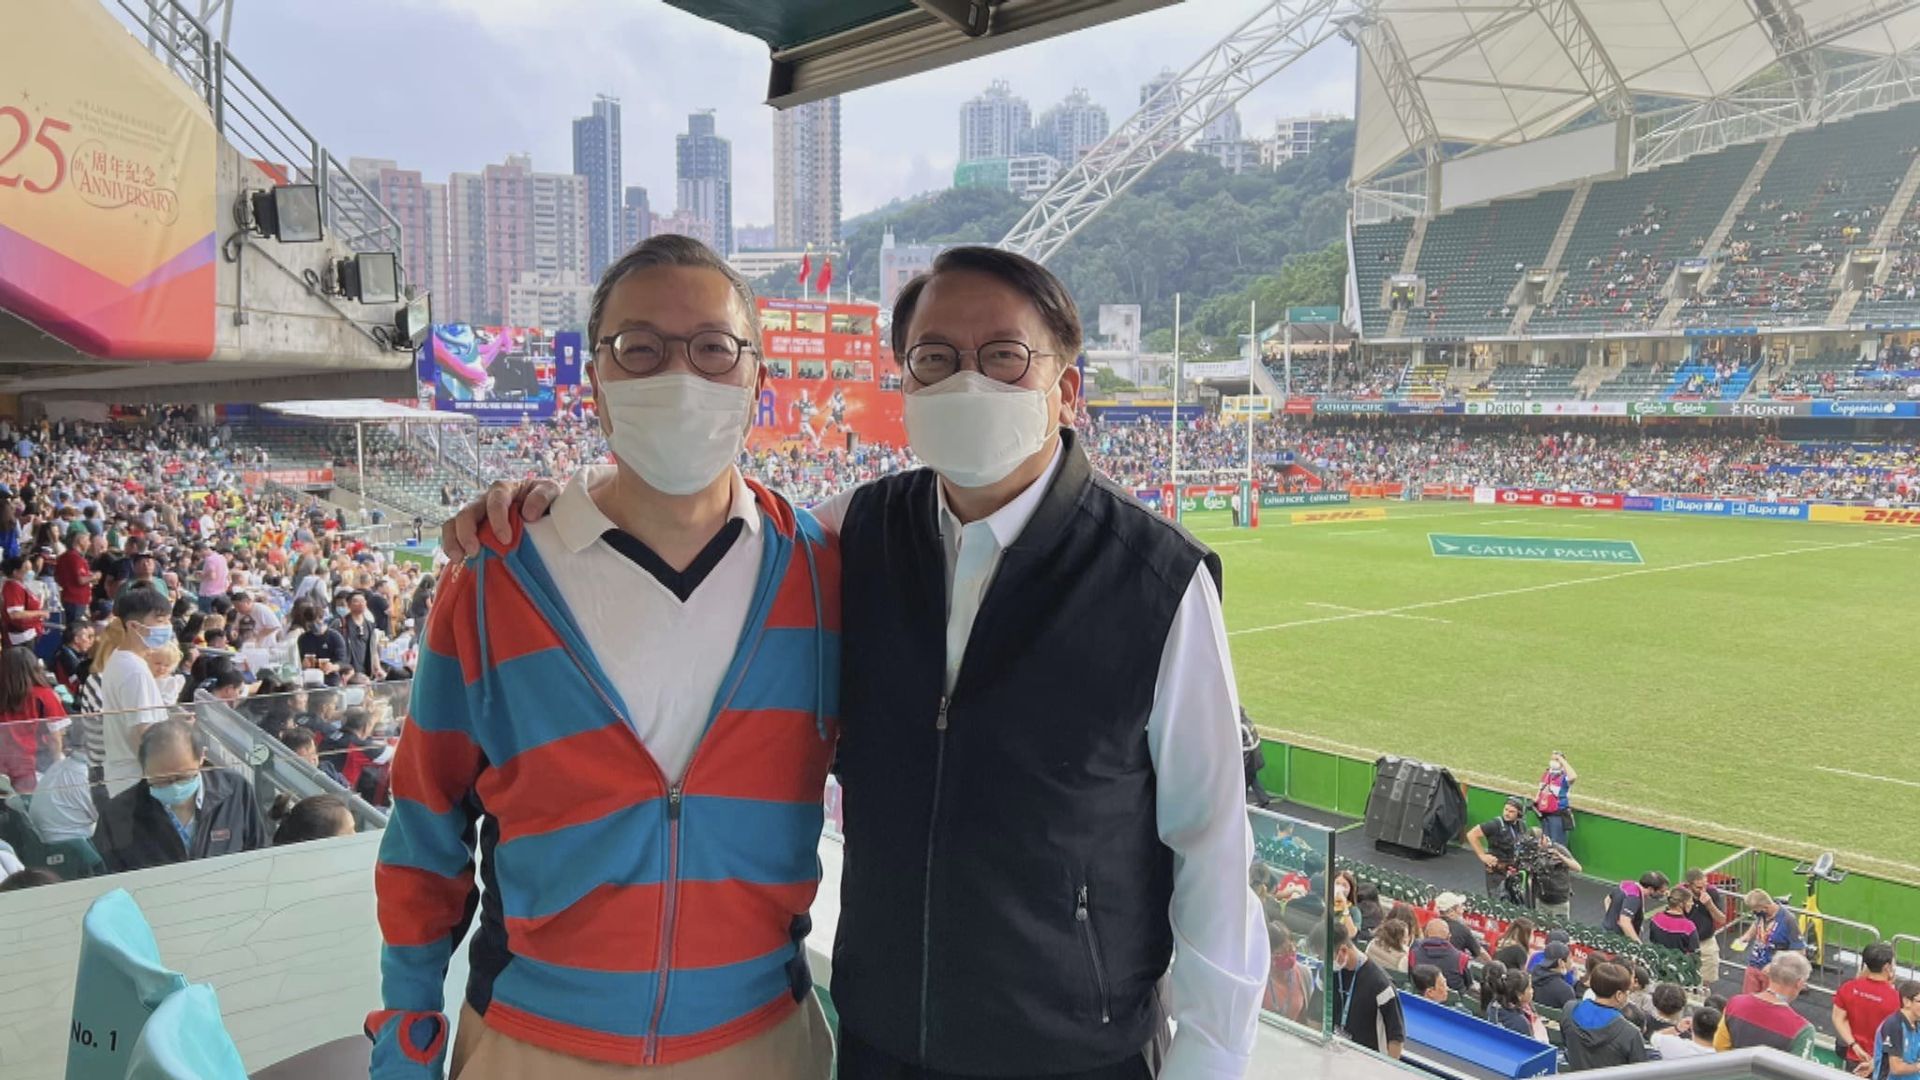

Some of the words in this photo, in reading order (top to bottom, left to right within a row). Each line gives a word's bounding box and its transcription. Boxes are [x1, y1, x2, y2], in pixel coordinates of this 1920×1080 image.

[0, 106, 71, 194] 25
[92, 149, 157, 187] 周年紀念
[79, 168, 174, 212] ANNIVERSARY
[1316, 403, 1350, 412] CATHAY
[1351, 403, 1384, 412] PACIFIC
[1485, 401, 1525, 415] Dettol
[1743, 403, 1795, 416] KUKRI
[1830, 402, 1884, 417] Capgemini
[1675, 501, 1703, 512] Bupa
[1747, 504, 1777, 515] Bupa
[1467, 543, 1548, 557] CATHAY
[1551, 547, 1635, 560] PACIFIC
[70, 1019, 98, 1049] No.
[109, 1030, 118, 1052] 1
